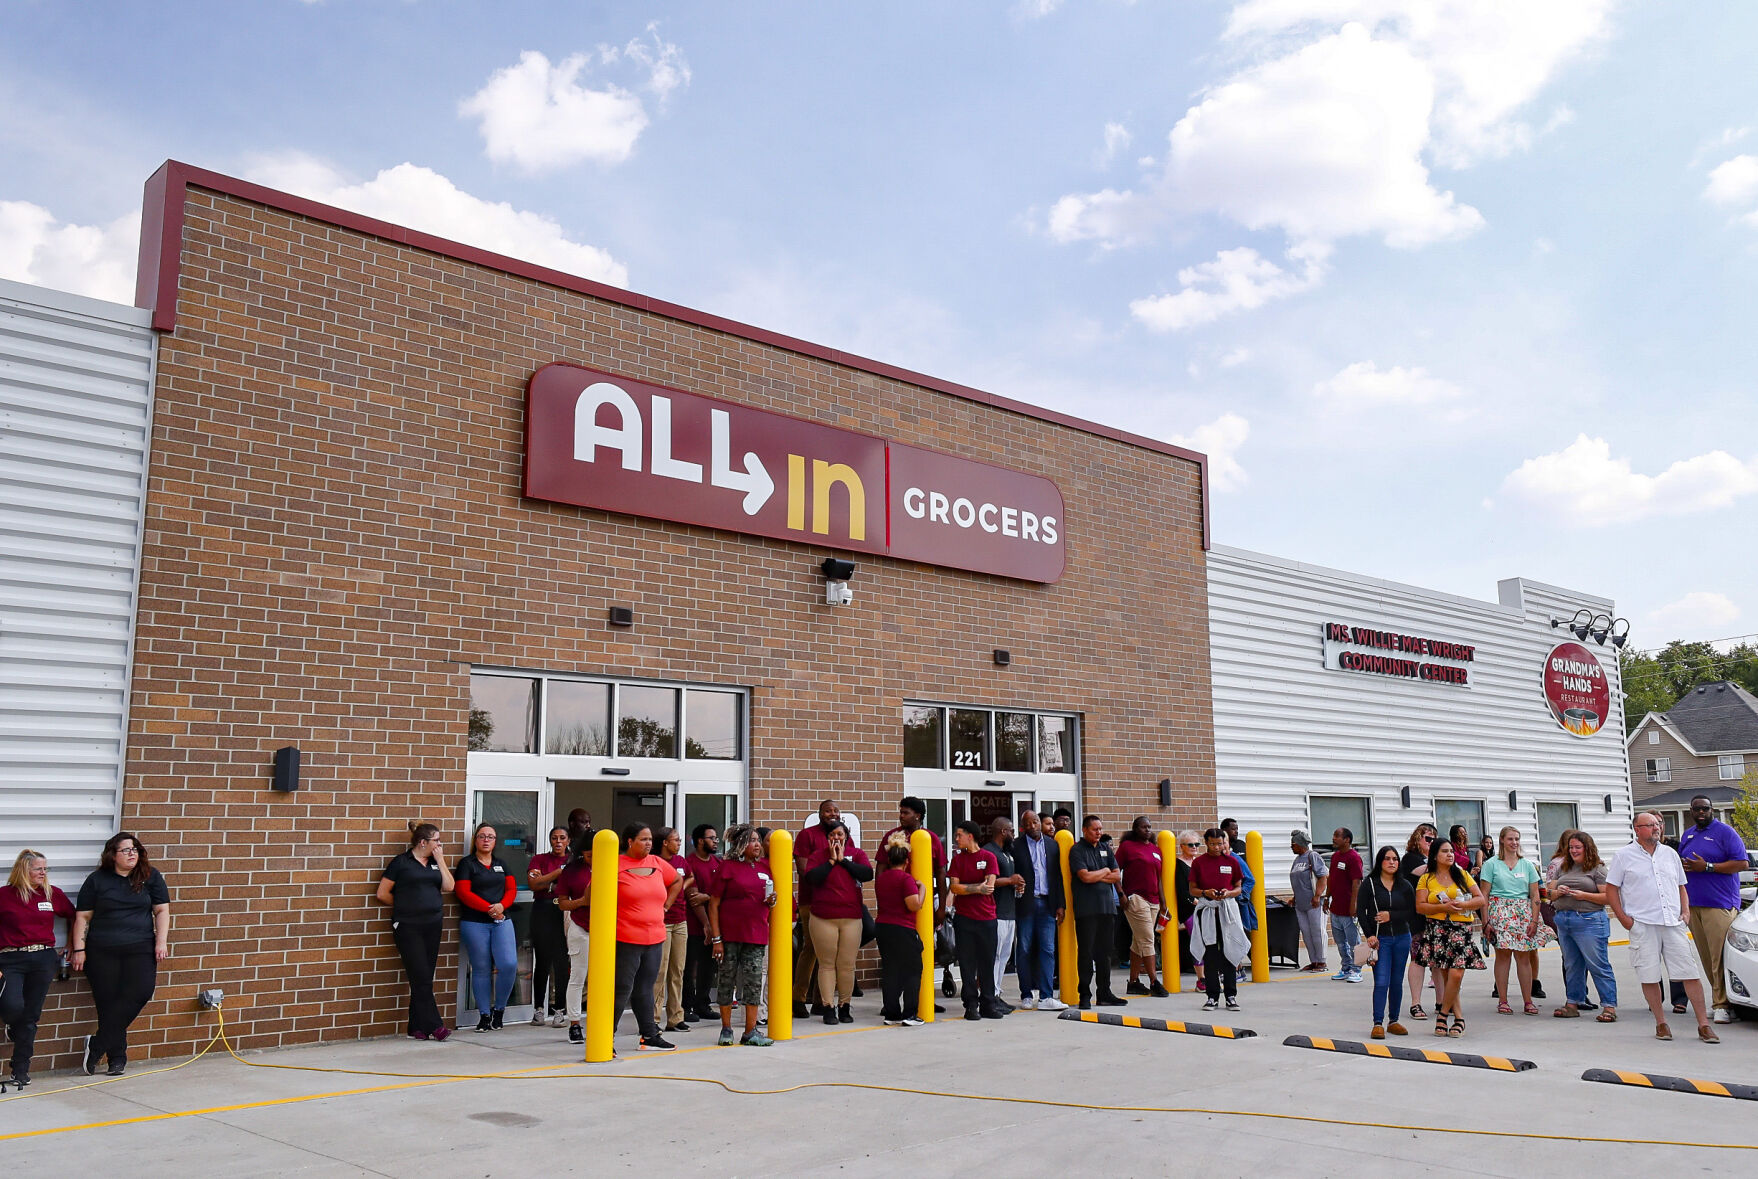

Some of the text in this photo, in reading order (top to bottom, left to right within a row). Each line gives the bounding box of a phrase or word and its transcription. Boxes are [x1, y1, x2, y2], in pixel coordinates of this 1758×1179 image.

[573, 382, 775, 516] ALL
[903, 487, 1059, 545] GROCERS
[1326, 623, 1475, 662] MS. WILLIE MAE WRIGHT
[1339, 651, 1468, 684] COMMUNITY CENTER
[1552, 658, 1600, 679] GRANDMA'S
[1563, 676, 1592, 693] HANDS
[1561, 694, 1596, 704] RESTAURANT
[954, 751, 981, 767] 221
